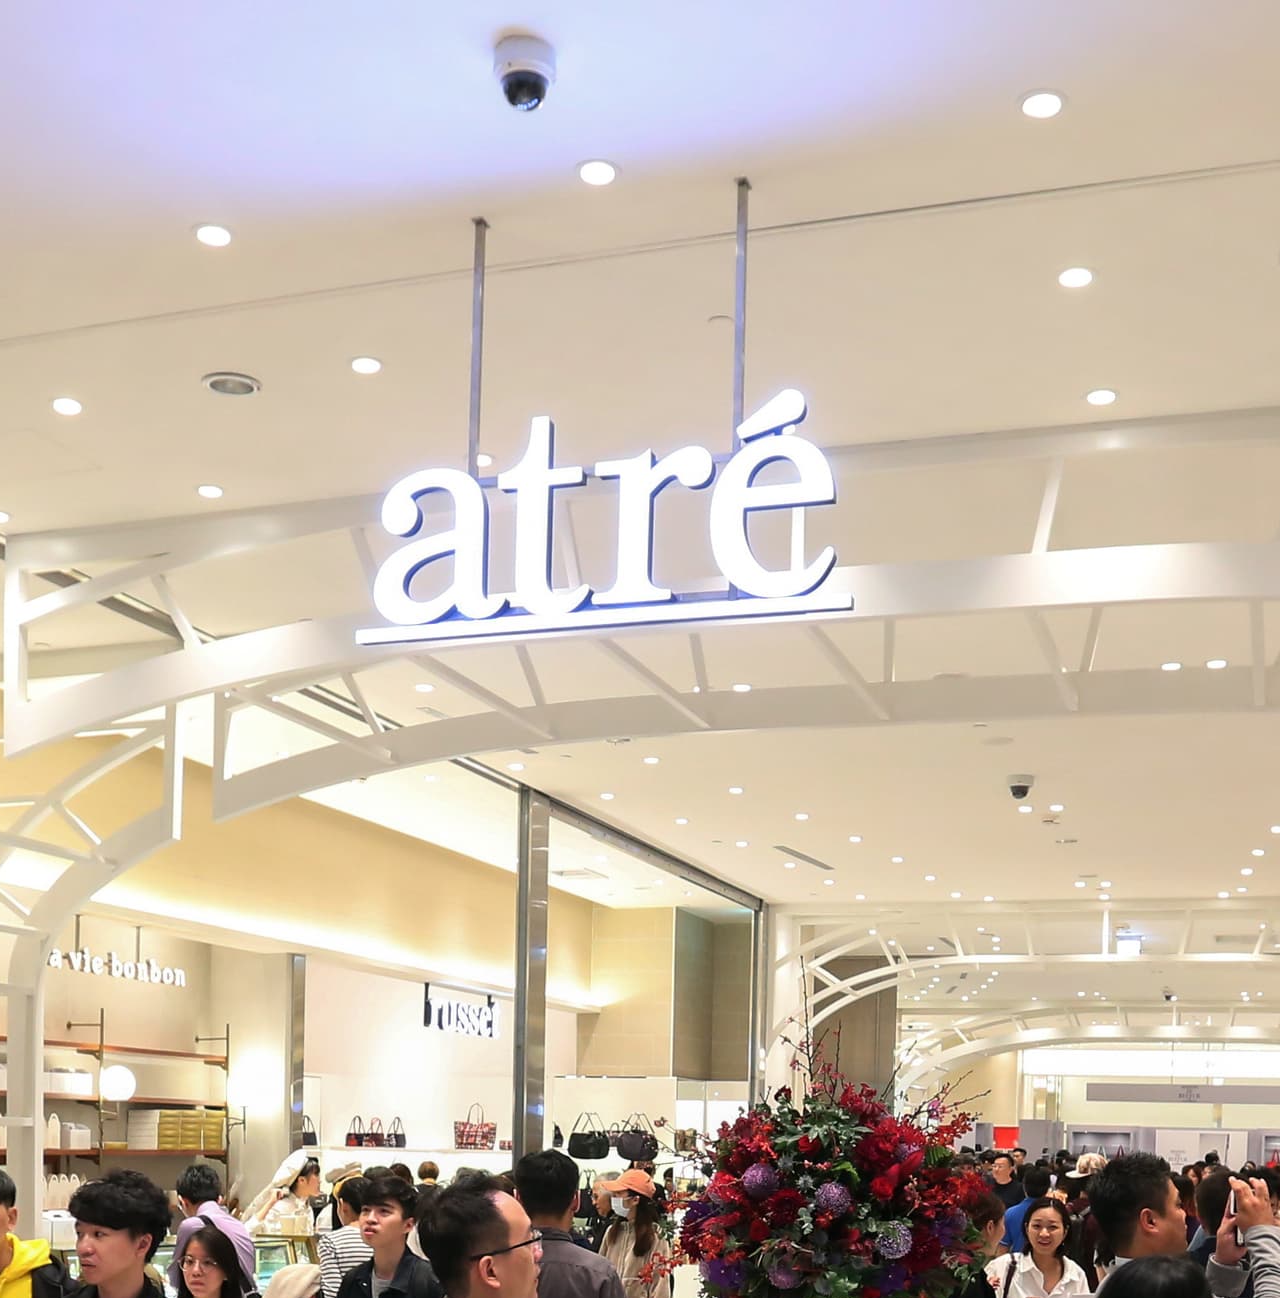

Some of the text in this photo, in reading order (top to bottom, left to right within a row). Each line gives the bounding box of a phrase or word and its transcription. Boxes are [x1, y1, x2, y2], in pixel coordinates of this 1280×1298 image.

[373, 388, 837, 626] atré
[68, 946, 105, 976] vie
[110, 951, 186, 987] bonbon
[425, 997, 501, 1040] russet
